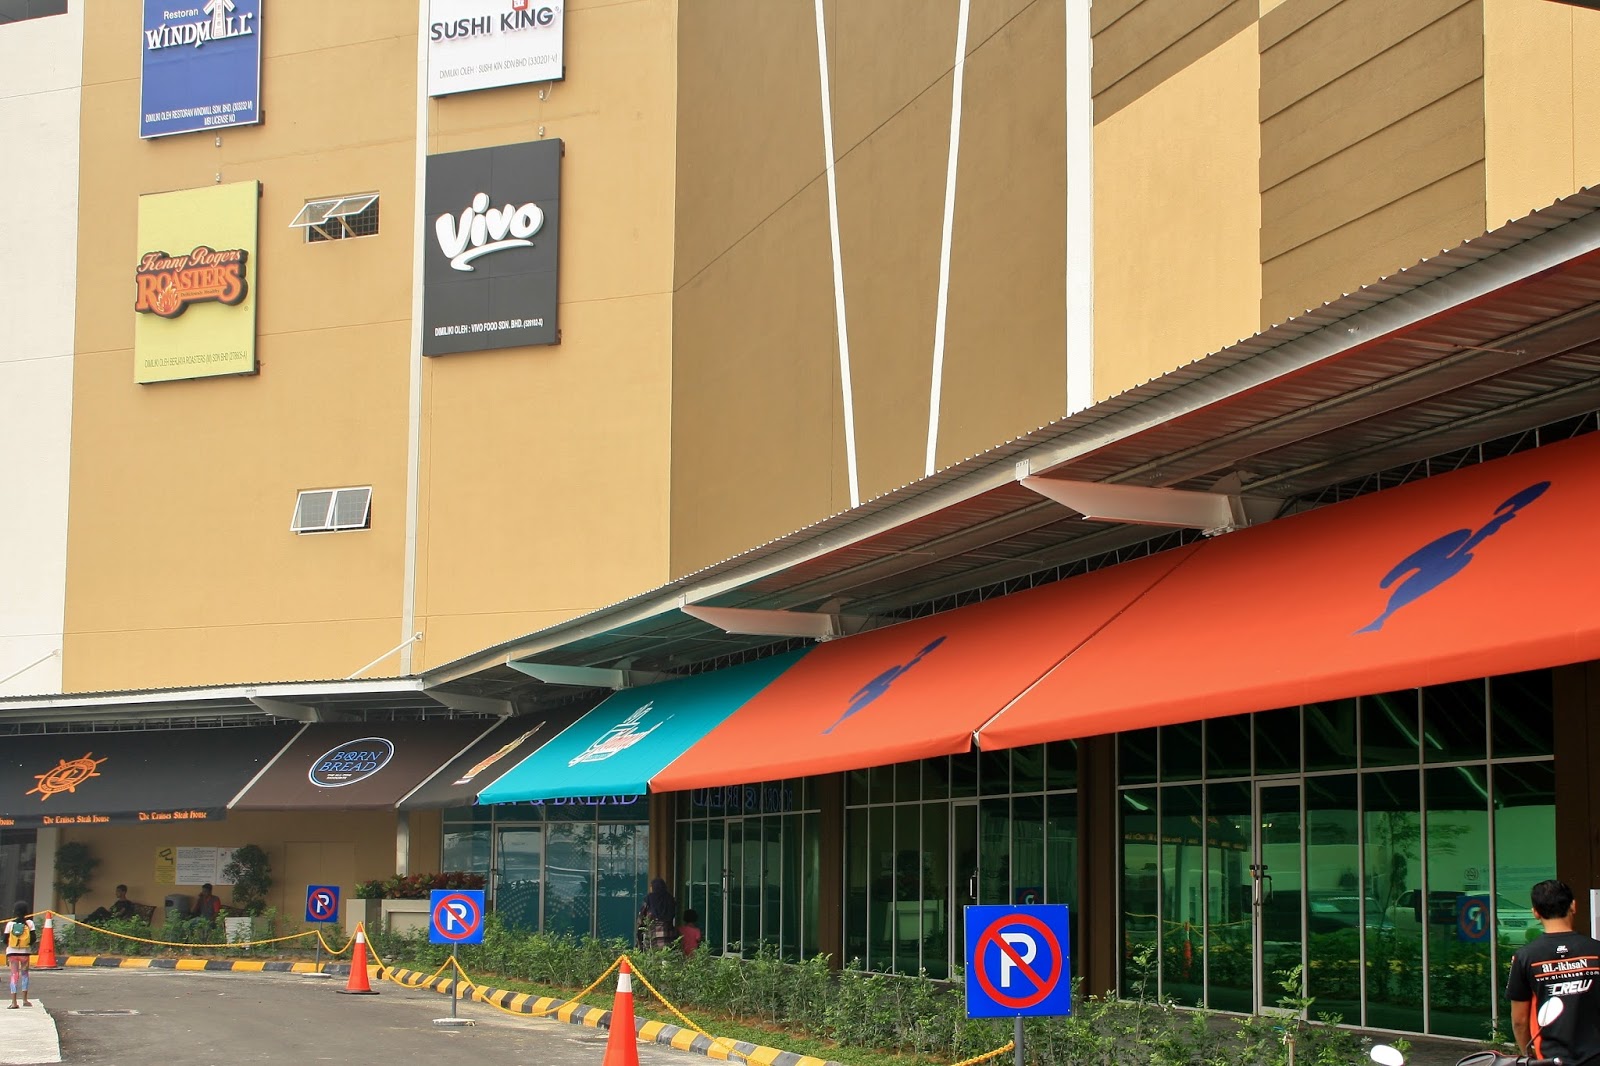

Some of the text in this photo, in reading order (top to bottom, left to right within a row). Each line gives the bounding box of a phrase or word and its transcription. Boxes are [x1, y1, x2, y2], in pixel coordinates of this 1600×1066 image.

[163, 8, 199, 20] Restoran
[431, 7, 554, 41] SUSHI KING
[460, 66, 475, 76] OLEH
[478, 63, 493, 74] SUSHI
[172, 108, 194, 119] RESTORAN
[211, 115, 229, 125] LICENSE
[138, 246, 241, 272] Kenny Rogers
[136, 264, 241, 315] ROASTERS
[454, 324, 468, 334] OLEH
[471, 323, 484, 333] VIVO
[483, 322, 498, 332] FOOD
[498, 320, 511, 330] SDN.
[318, 761, 377, 772] BREAD
[43, 815, 54, 824] The
[55, 815, 75, 824] Cruises
[76, 815, 92, 823] Steak
[138, 812, 150, 820] The
[151, 812, 172, 820] Cruises
[173, 810, 189, 819] Steak
[316, 894, 330, 914] P
[446, 903, 467, 931] P
[1000, 932, 1037, 988] P
[1549, 979, 1593, 996] CREW
